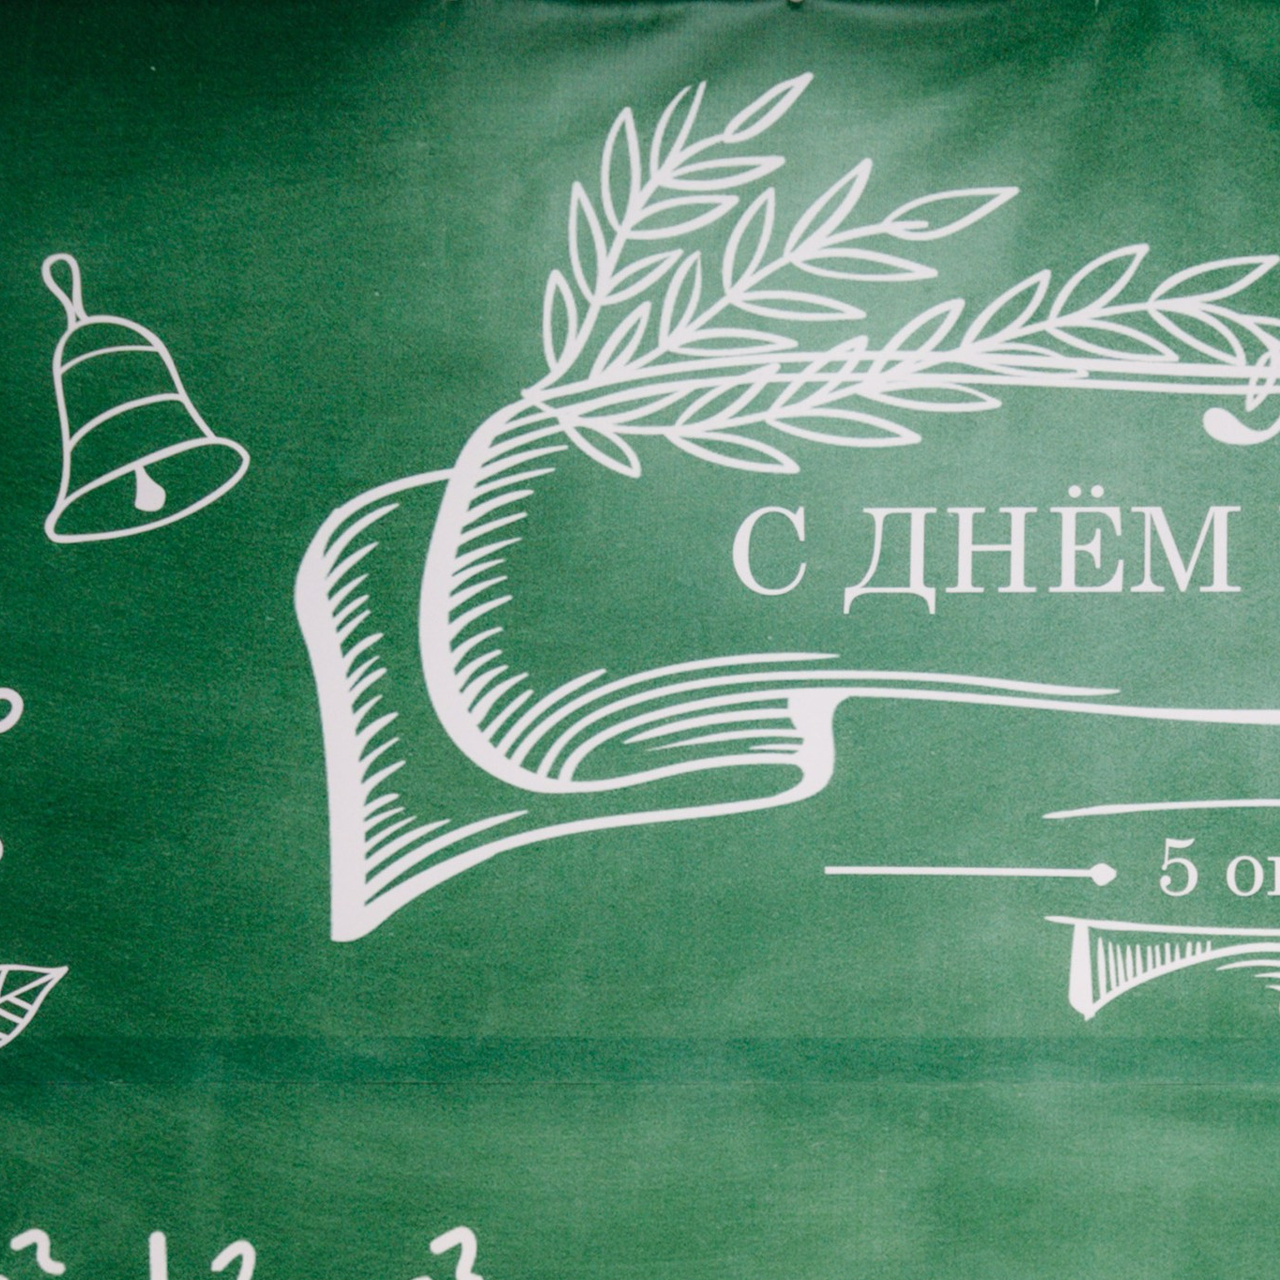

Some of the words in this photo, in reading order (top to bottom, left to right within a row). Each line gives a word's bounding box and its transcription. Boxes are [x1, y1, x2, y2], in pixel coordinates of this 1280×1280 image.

[731, 505, 808, 596] С
[842, 484, 1243, 615] ДНЁМ
[1159, 836, 1200, 898] 5
